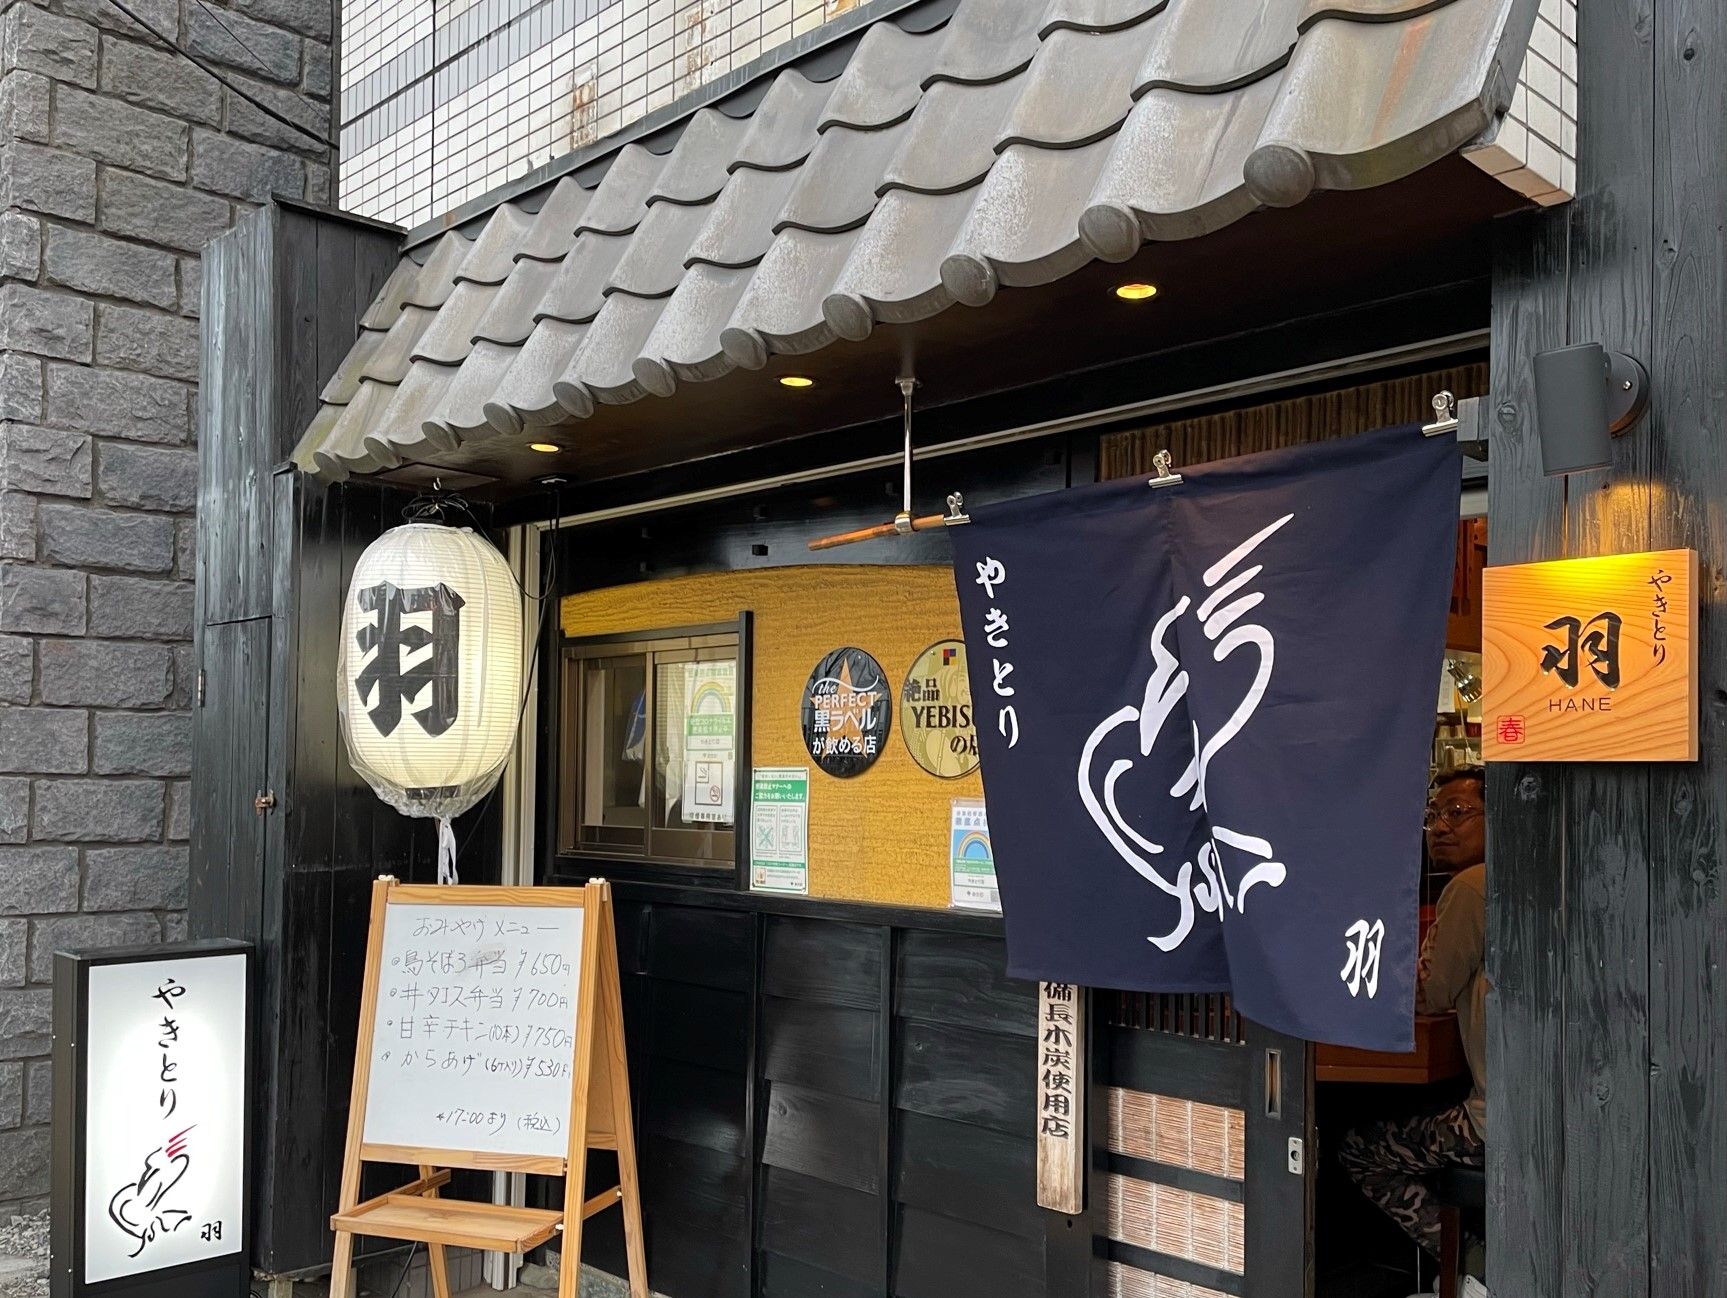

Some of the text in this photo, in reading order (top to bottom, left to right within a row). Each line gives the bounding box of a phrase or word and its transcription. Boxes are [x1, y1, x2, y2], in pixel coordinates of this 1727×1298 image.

[1647, 569, 1672, 667] やきとり
[355, 580, 466, 739] 羽
[975, 556, 1019, 749] やきとり
[1540, 611, 1623, 692] 羽
[818, 680, 837, 694] the
[904, 677, 940, 702] 絶品
[814, 692, 877, 709] PERFECT
[1549, 697, 1612, 712] HANE
[814, 708, 877, 733] 黒ラベル
[911, 704, 971, 729] YEBIS
[1498, 717, 1524, 743] 春
[812, 734, 877, 755] が飲める店
[1340, 918, 1385, 999] 羽
[152, 978, 187, 1120] やきとり
[200, 1220, 223, 1242] 羽
